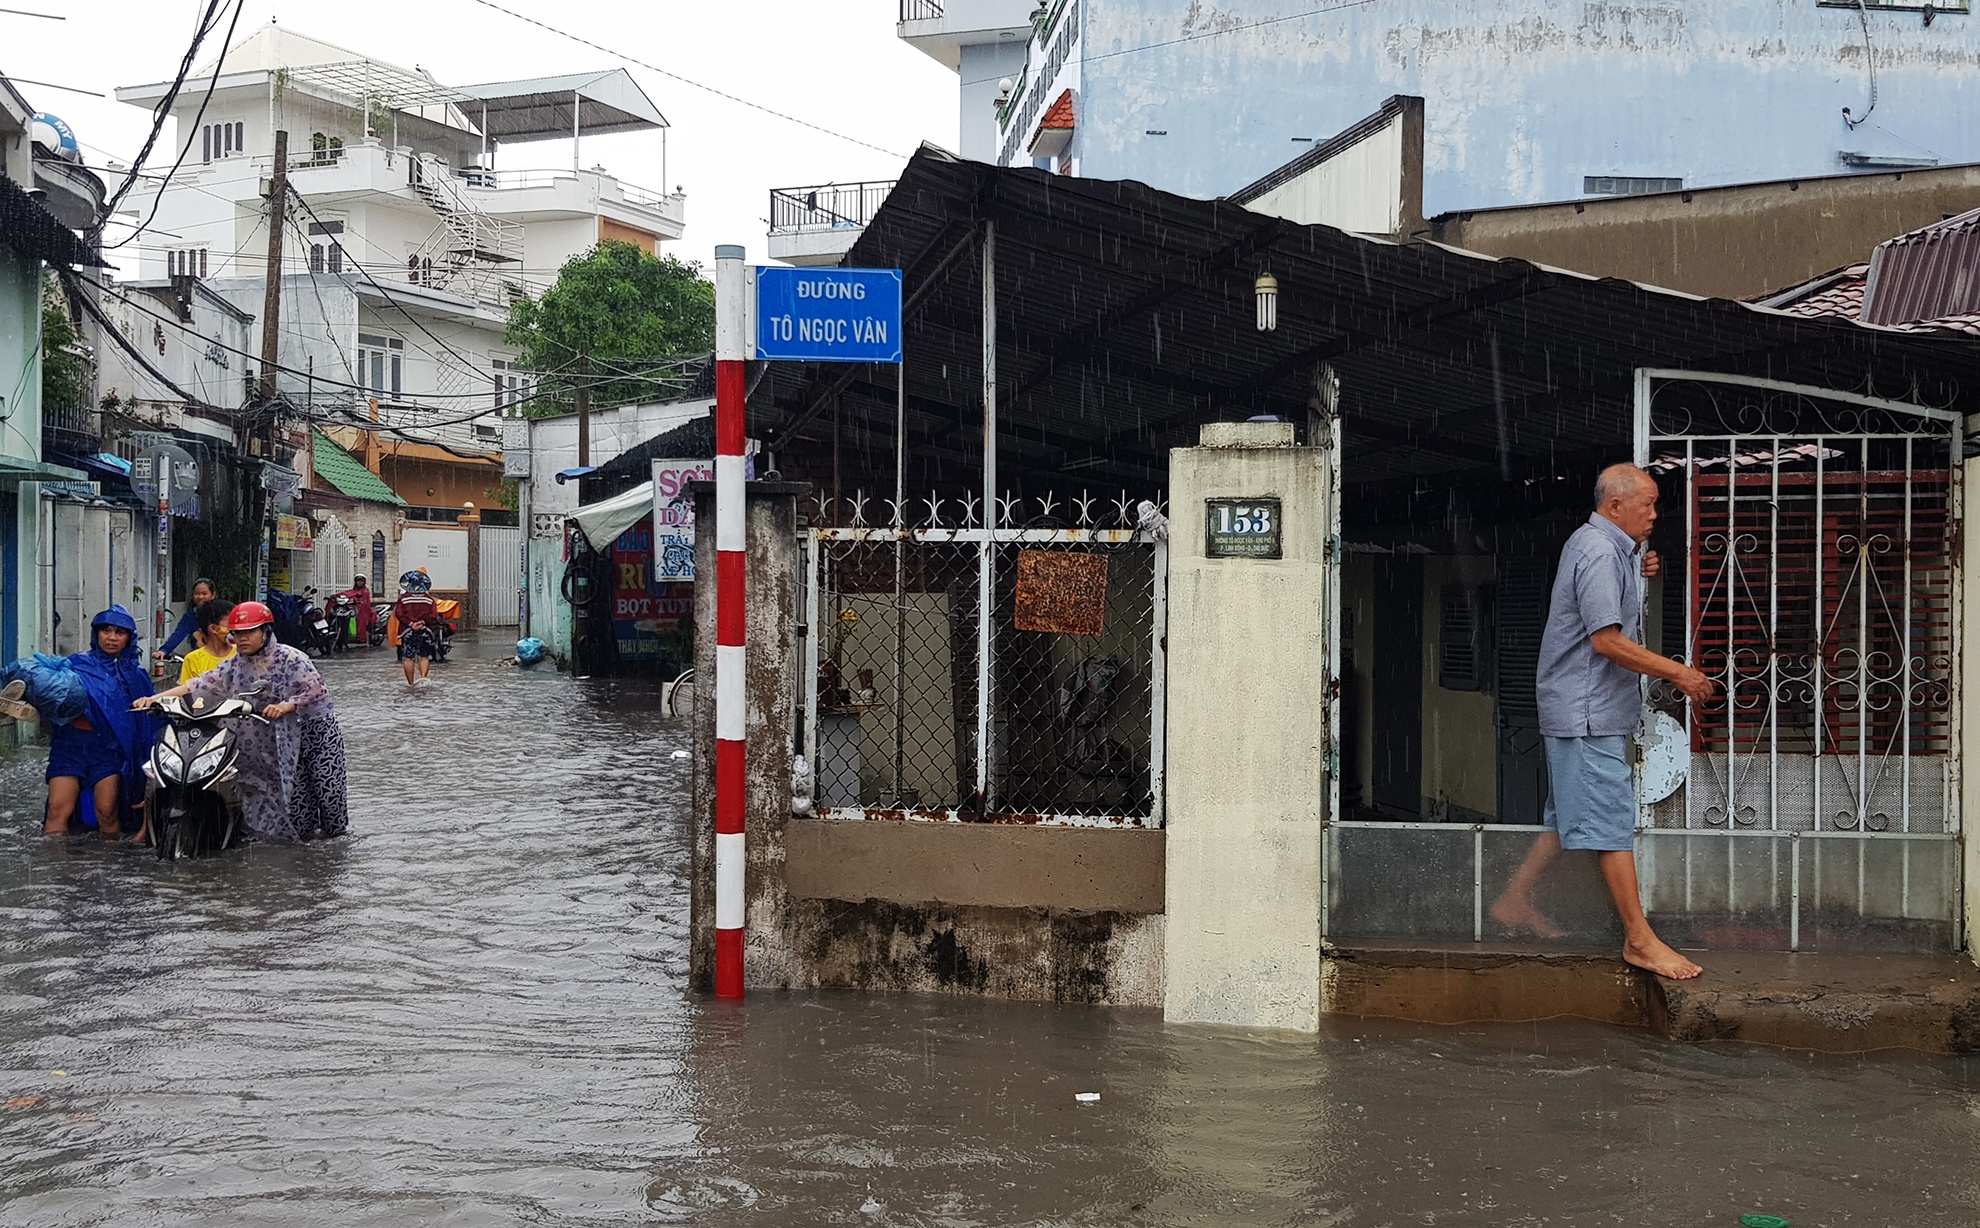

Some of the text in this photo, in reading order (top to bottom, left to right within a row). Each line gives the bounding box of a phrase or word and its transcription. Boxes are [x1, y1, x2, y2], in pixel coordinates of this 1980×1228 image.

[797, 276, 866, 300] ĐƯỜNG
[770, 313, 887, 346] TÔ NGỌC VÂN
[1217, 507, 1271, 534] 153
[616, 597, 652, 618] BỌT
